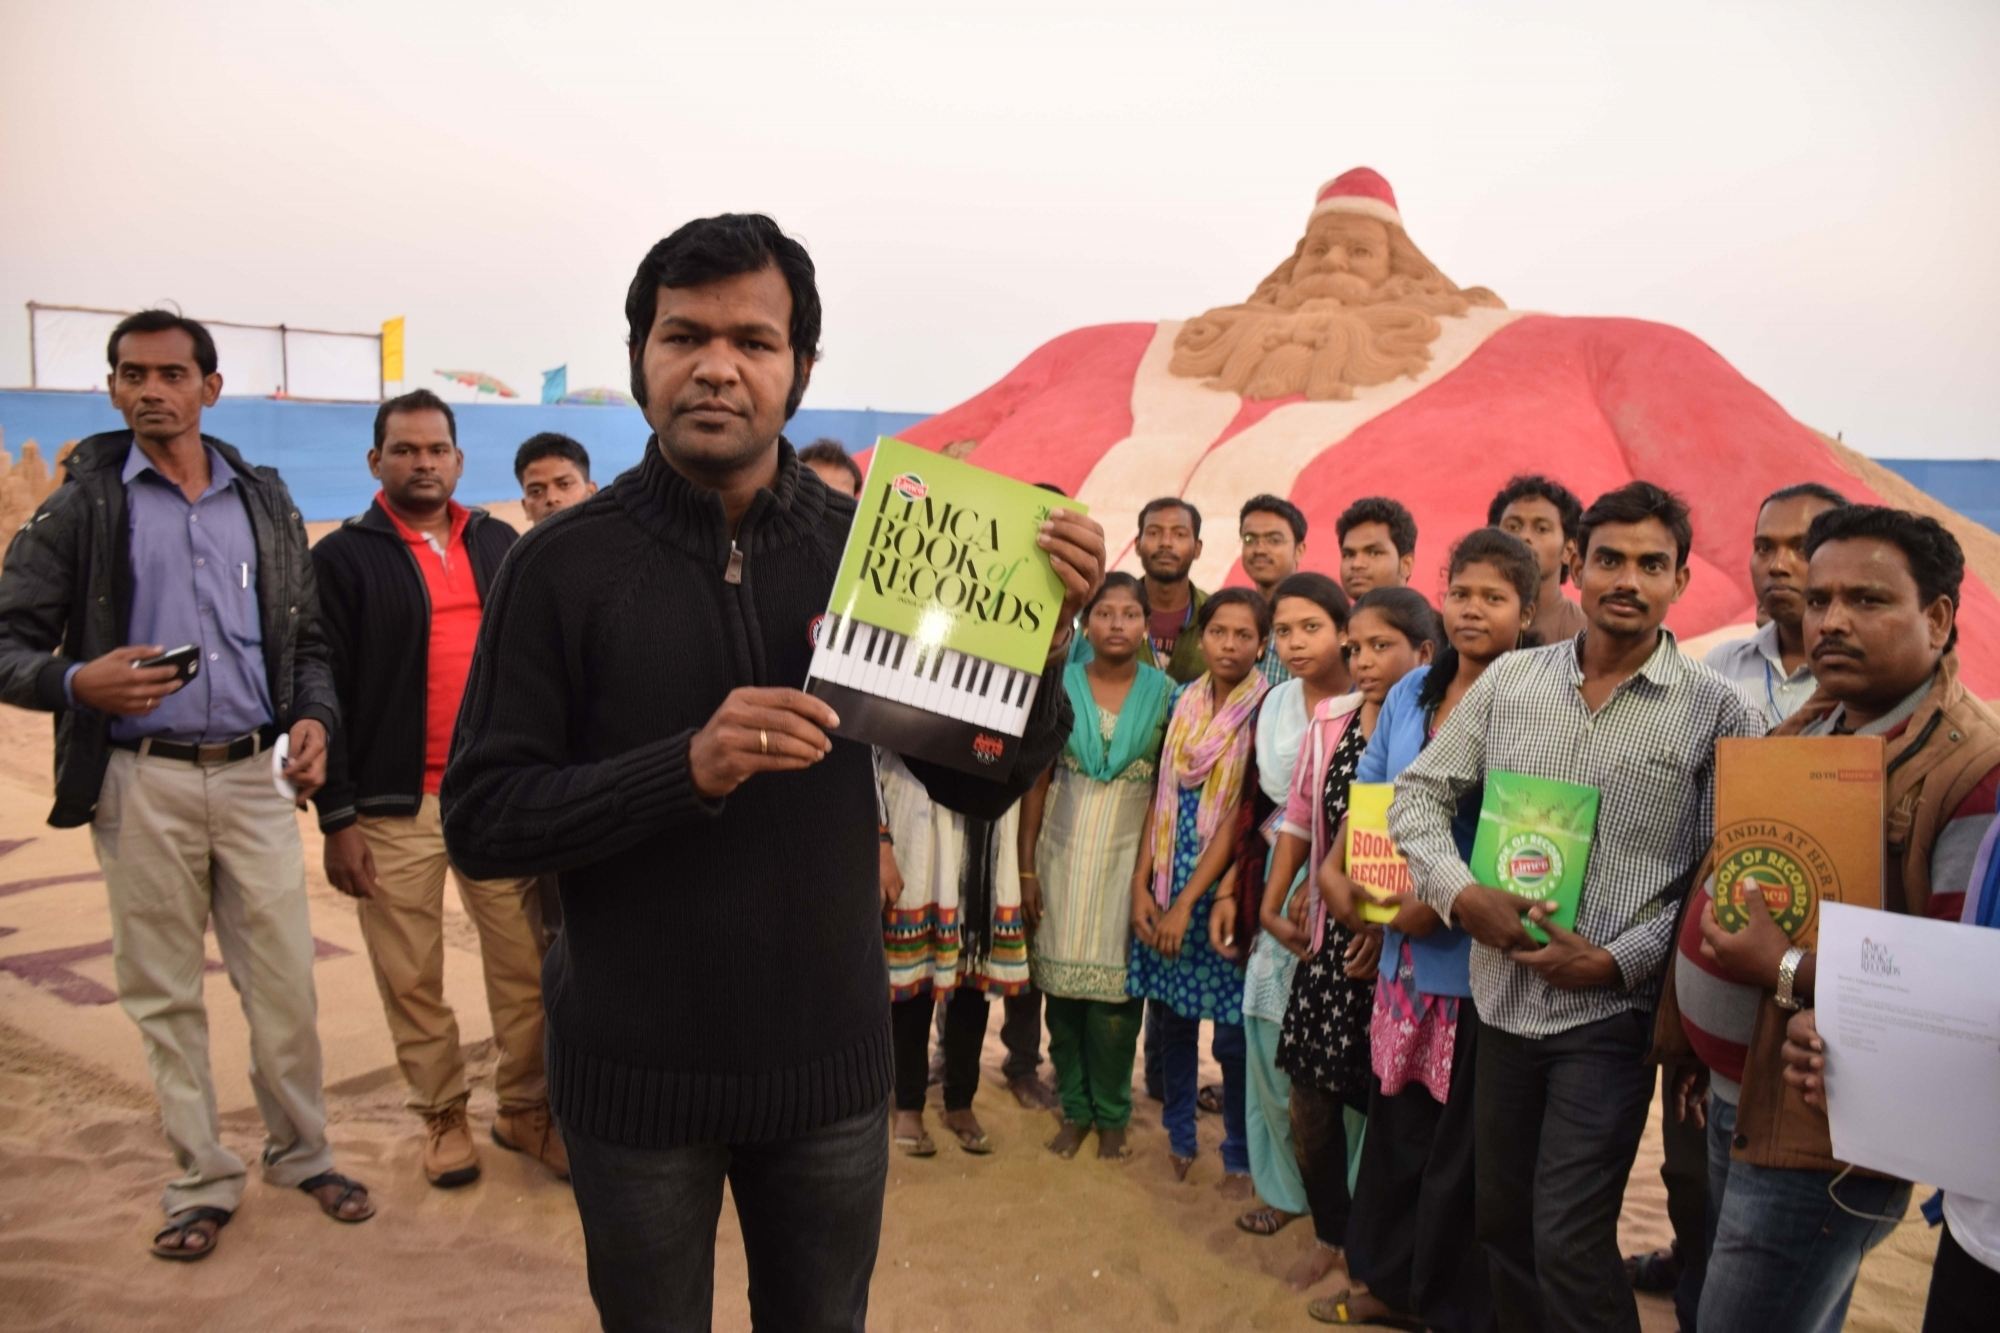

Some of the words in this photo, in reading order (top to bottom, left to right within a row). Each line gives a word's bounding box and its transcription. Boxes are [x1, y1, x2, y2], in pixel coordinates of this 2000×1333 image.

[878, 483, 999, 552] LIMCA
[859, 548, 1043, 632] RECORDS
[868, 515, 978, 580] BOOK
[986, 556, 1029, 618] of
[1351, 830, 1393, 857] BOOK
[1511, 834, 1526, 849] OF
[1511, 860, 1550, 874] Limca
[1726, 825, 1778, 843] INDIA
[1783, 831, 1808, 849] AT
[1807, 848, 1834, 887] HER
[1717, 860, 1741, 906] BOOK
[1741, 849, 1763, 865] OF
[1767, 851, 1807, 918] RECORDS
[1734, 881, 1788, 903] Lca
